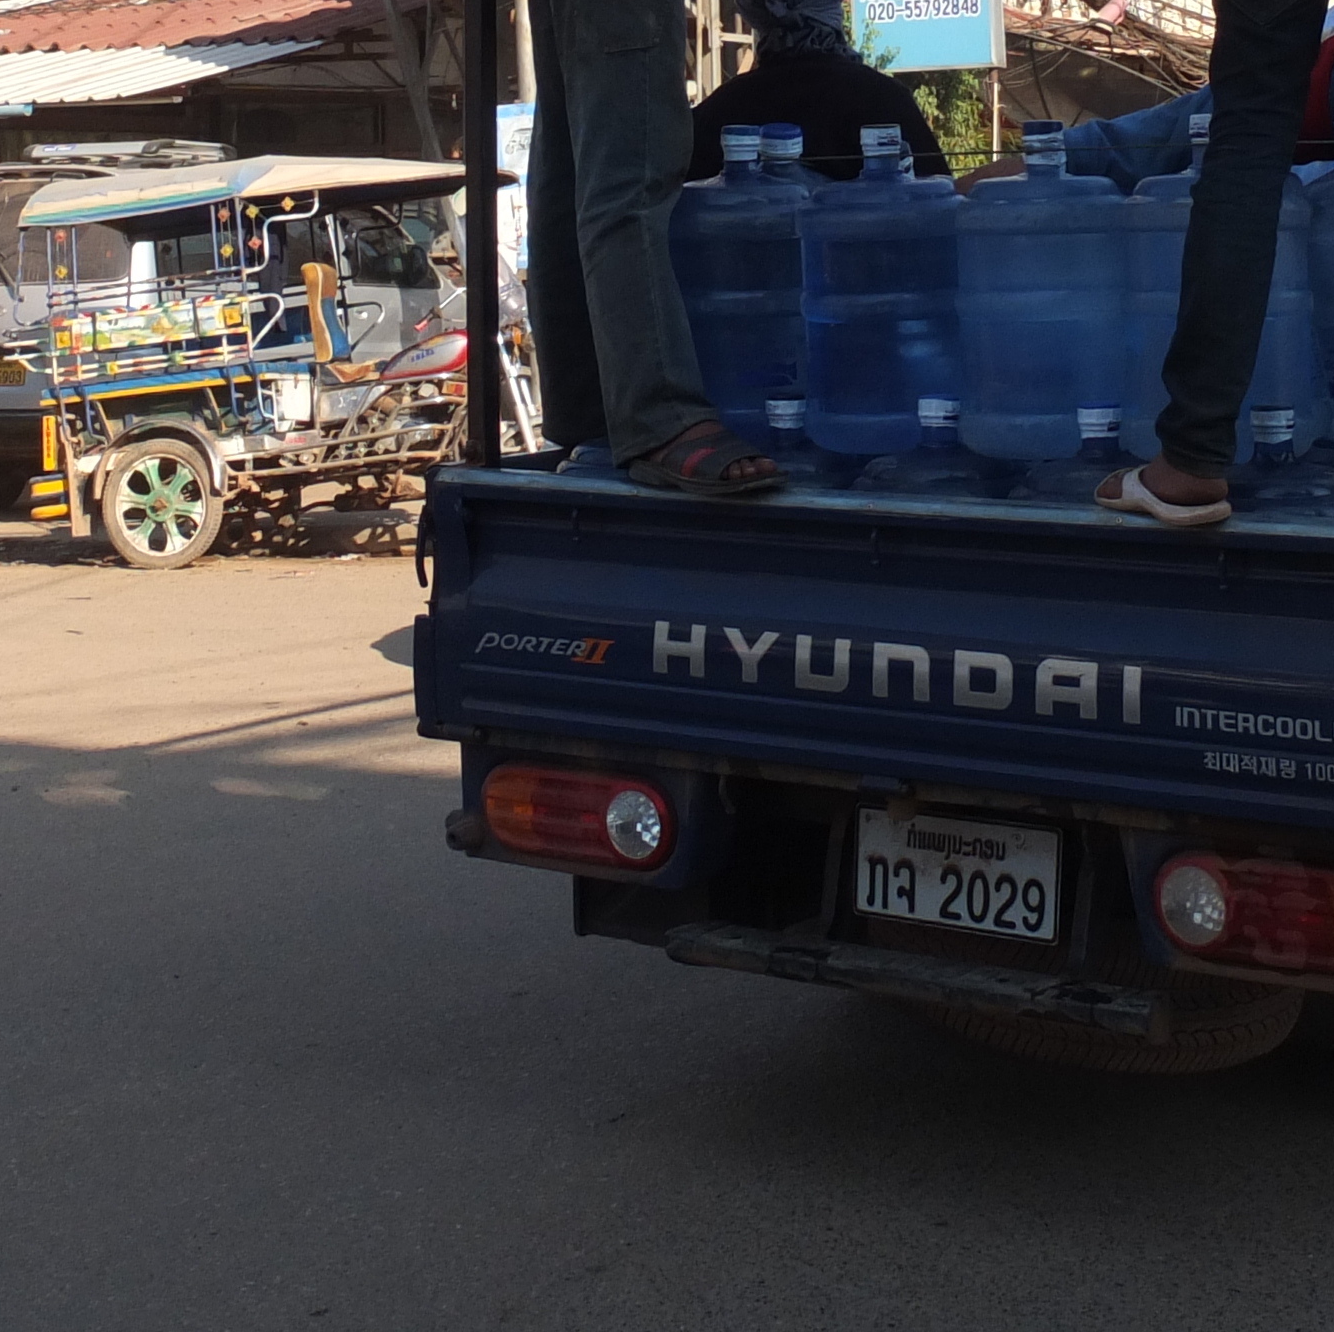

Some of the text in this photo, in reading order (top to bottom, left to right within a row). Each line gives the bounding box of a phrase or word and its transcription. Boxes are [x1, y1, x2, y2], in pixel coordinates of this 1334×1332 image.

[652, 619, 1145, 726] HYUNDAI
[1203, 751, 1297, 780] 최대적재량
[938, 861, 1046, 933] 2029
